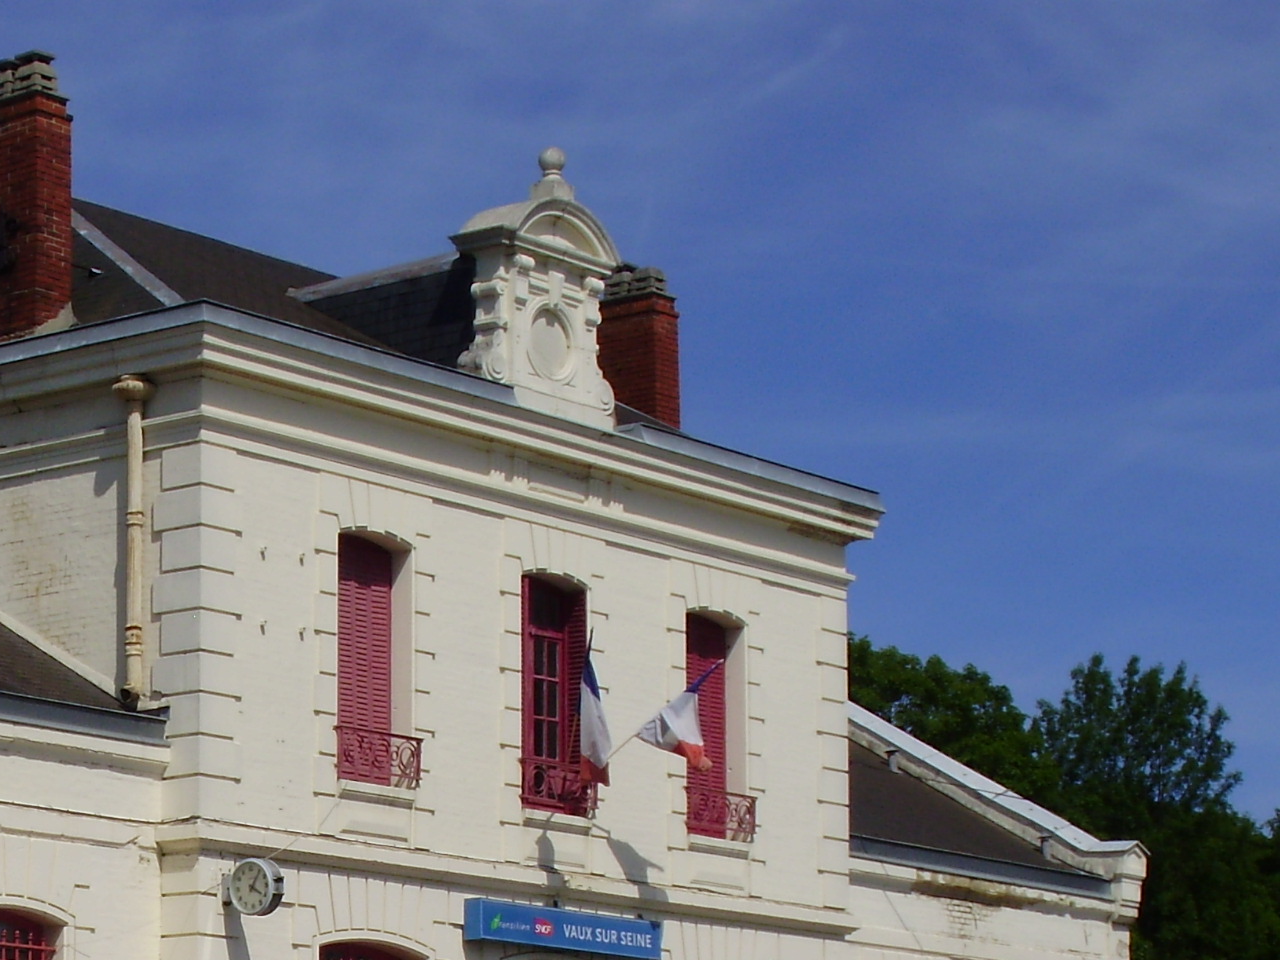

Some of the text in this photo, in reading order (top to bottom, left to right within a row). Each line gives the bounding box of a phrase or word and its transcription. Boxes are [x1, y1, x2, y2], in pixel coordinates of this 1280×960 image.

[563, 923, 652, 948] VAUX SUR SEINE
